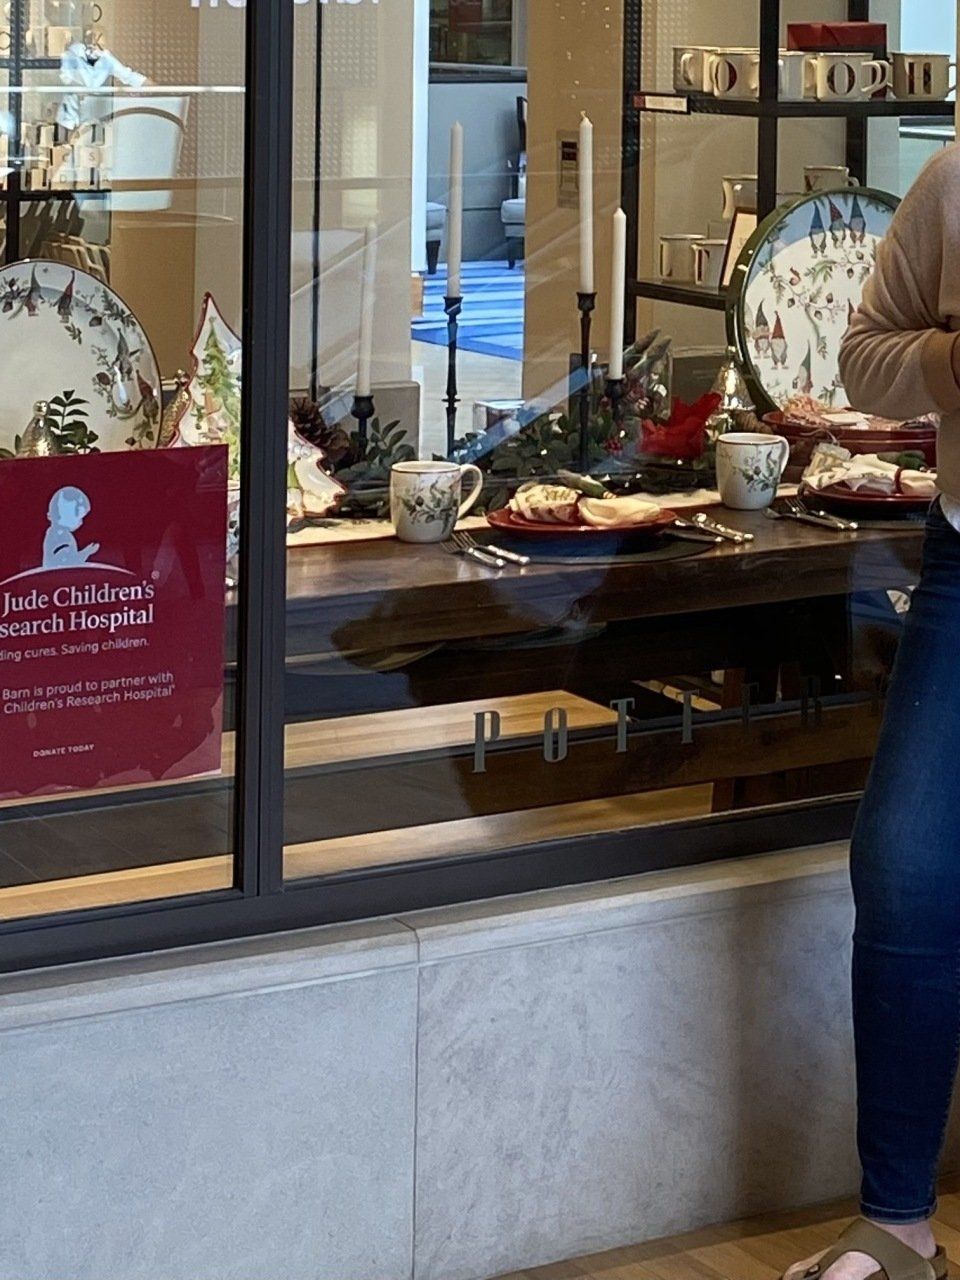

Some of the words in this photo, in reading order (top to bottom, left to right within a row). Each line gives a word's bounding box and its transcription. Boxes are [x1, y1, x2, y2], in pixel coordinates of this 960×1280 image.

[1, 589, 50, 618] Jude
[52, 579, 156, 608] Children's
[68, 603, 155, 634] Hospital
[61, 641, 100, 656] Saving
[101, 636, 150, 651] children.
[33, 686, 43, 696] is
[46, 681, 83, 697] proud
[85, 680, 99, 691] to
[101, 674, 146, 690] partner
[148, 671, 175, 684] with
[3, 697, 64, 714] Children's
[66, 691, 121, 708] Research
